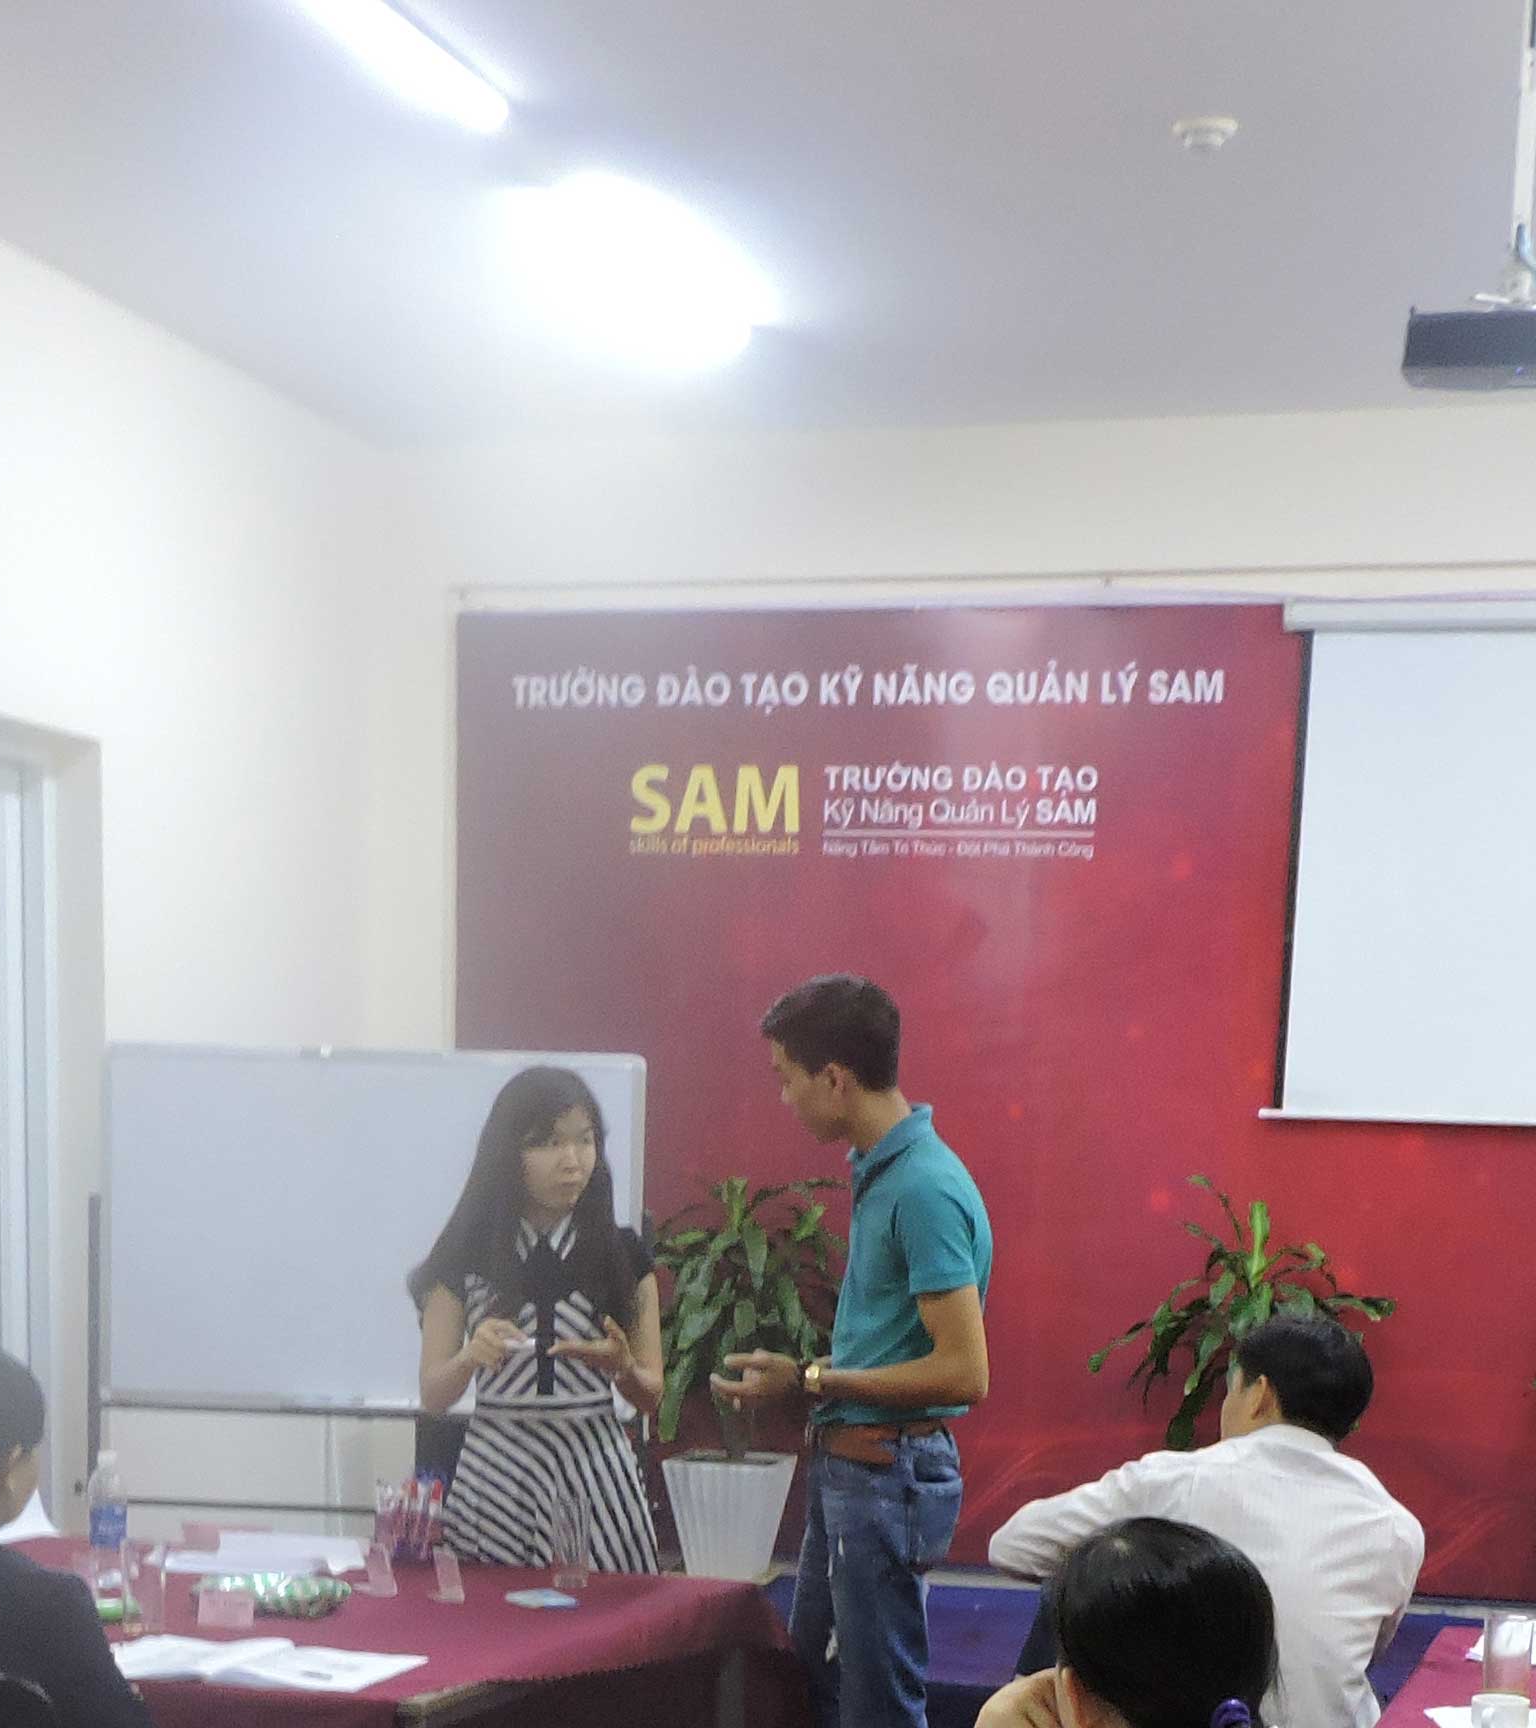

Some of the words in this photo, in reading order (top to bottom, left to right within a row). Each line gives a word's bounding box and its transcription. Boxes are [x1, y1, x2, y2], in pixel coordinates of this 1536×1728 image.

[513, 664, 647, 709] TRƯỜNG
[656, 664, 731, 706] ĐÀO
[740, 671, 808, 716] TẠO
[819, 663, 863, 706] KỸ
[986, 660, 1089, 705] QUẢN
[1101, 662, 1139, 704] LÝ
[1149, 670, 1224, 704] SAM
[630, 764, 800, 833] SAM
[1036, 765, 1098, 797] TẠO
[1002, 798, 1030, 829] Lý
[1036, 798, 1097, 824] SAM
